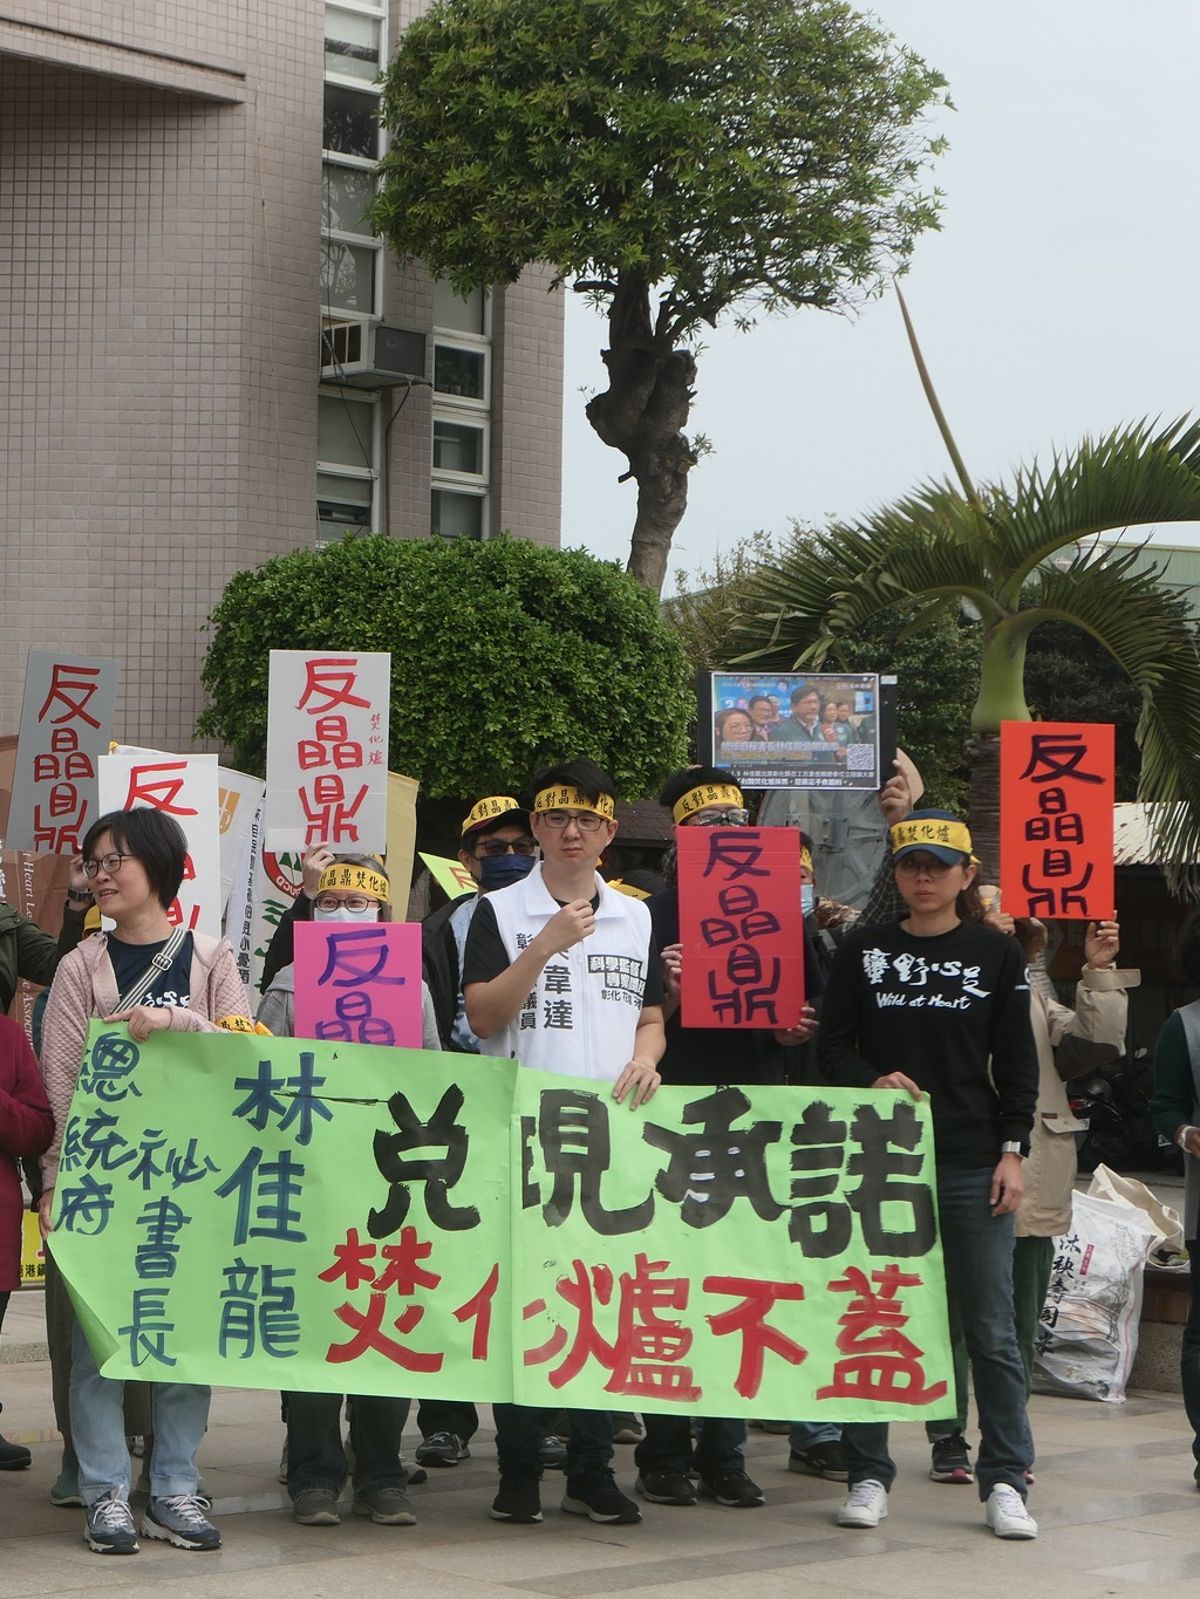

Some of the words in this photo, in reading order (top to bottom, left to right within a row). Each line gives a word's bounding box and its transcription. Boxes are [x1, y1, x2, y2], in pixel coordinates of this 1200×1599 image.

[296, 658, 373, 845] 反晶鼎
[1019, 733, 1108, 919] 反晶鼎
[700, 831, 783, 1026] 反晶鼎
[214, 1051, 336, 1360] 林佳龍
